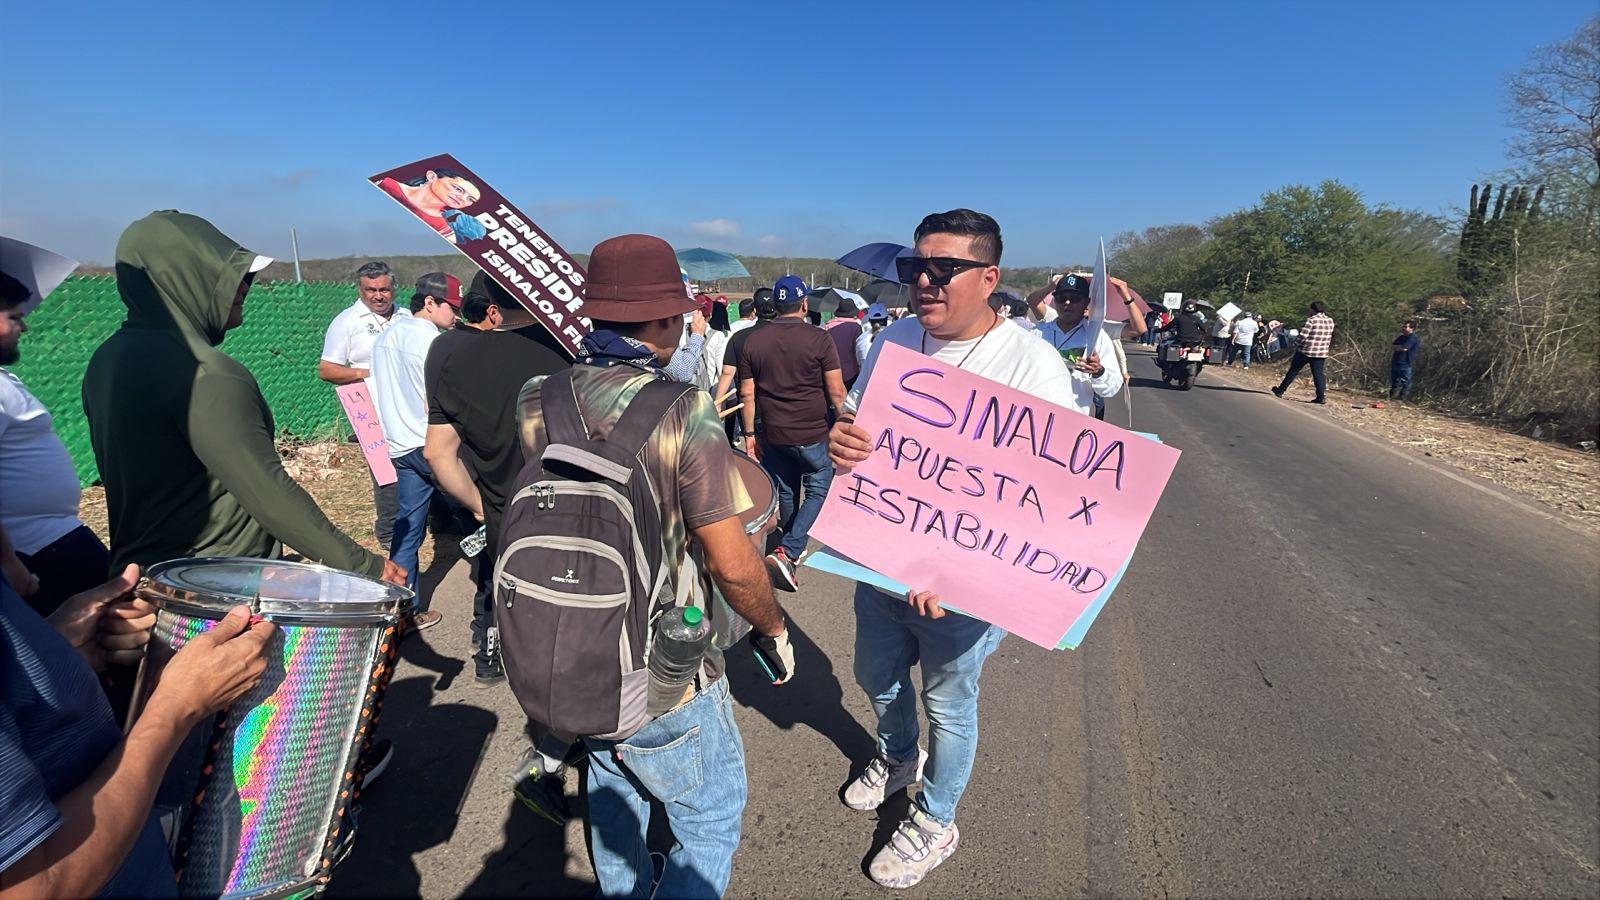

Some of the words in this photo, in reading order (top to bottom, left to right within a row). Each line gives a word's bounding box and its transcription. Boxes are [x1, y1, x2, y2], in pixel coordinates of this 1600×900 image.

[495, 203, 585, 287] TENEMOS
[562, 324, 584, 350] FI
[875, 428, 1045, 524] APUESTA
[892, 367, 1125, 491] SINALOA
[839, 472, 1106, 594] ESTABILIDAD
